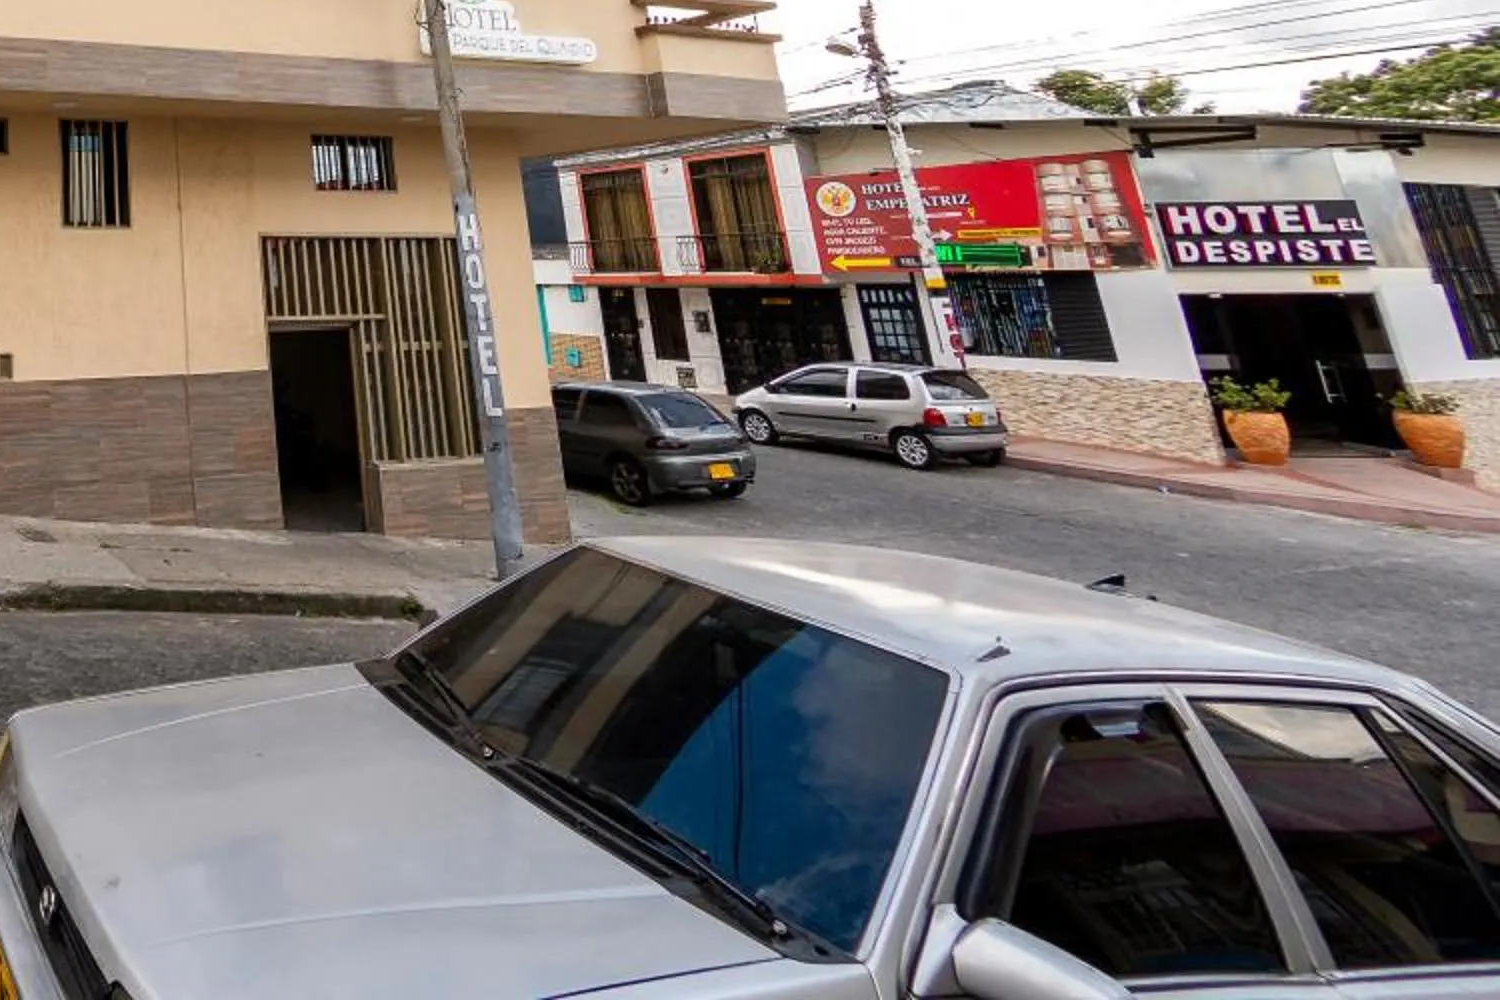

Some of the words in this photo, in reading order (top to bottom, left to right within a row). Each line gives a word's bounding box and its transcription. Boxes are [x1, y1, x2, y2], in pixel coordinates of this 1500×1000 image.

[861, 183, 904, 196] HOTE
[866, 193, 970, 211] EMPEATRIZ
[1166, 204, 1336, 235] HOTEL
[1336, 217, 1365, 231] EL
[1174, 239, 1376, 264] DESPISTE
[458, 213, 504, 417] HOTEL
